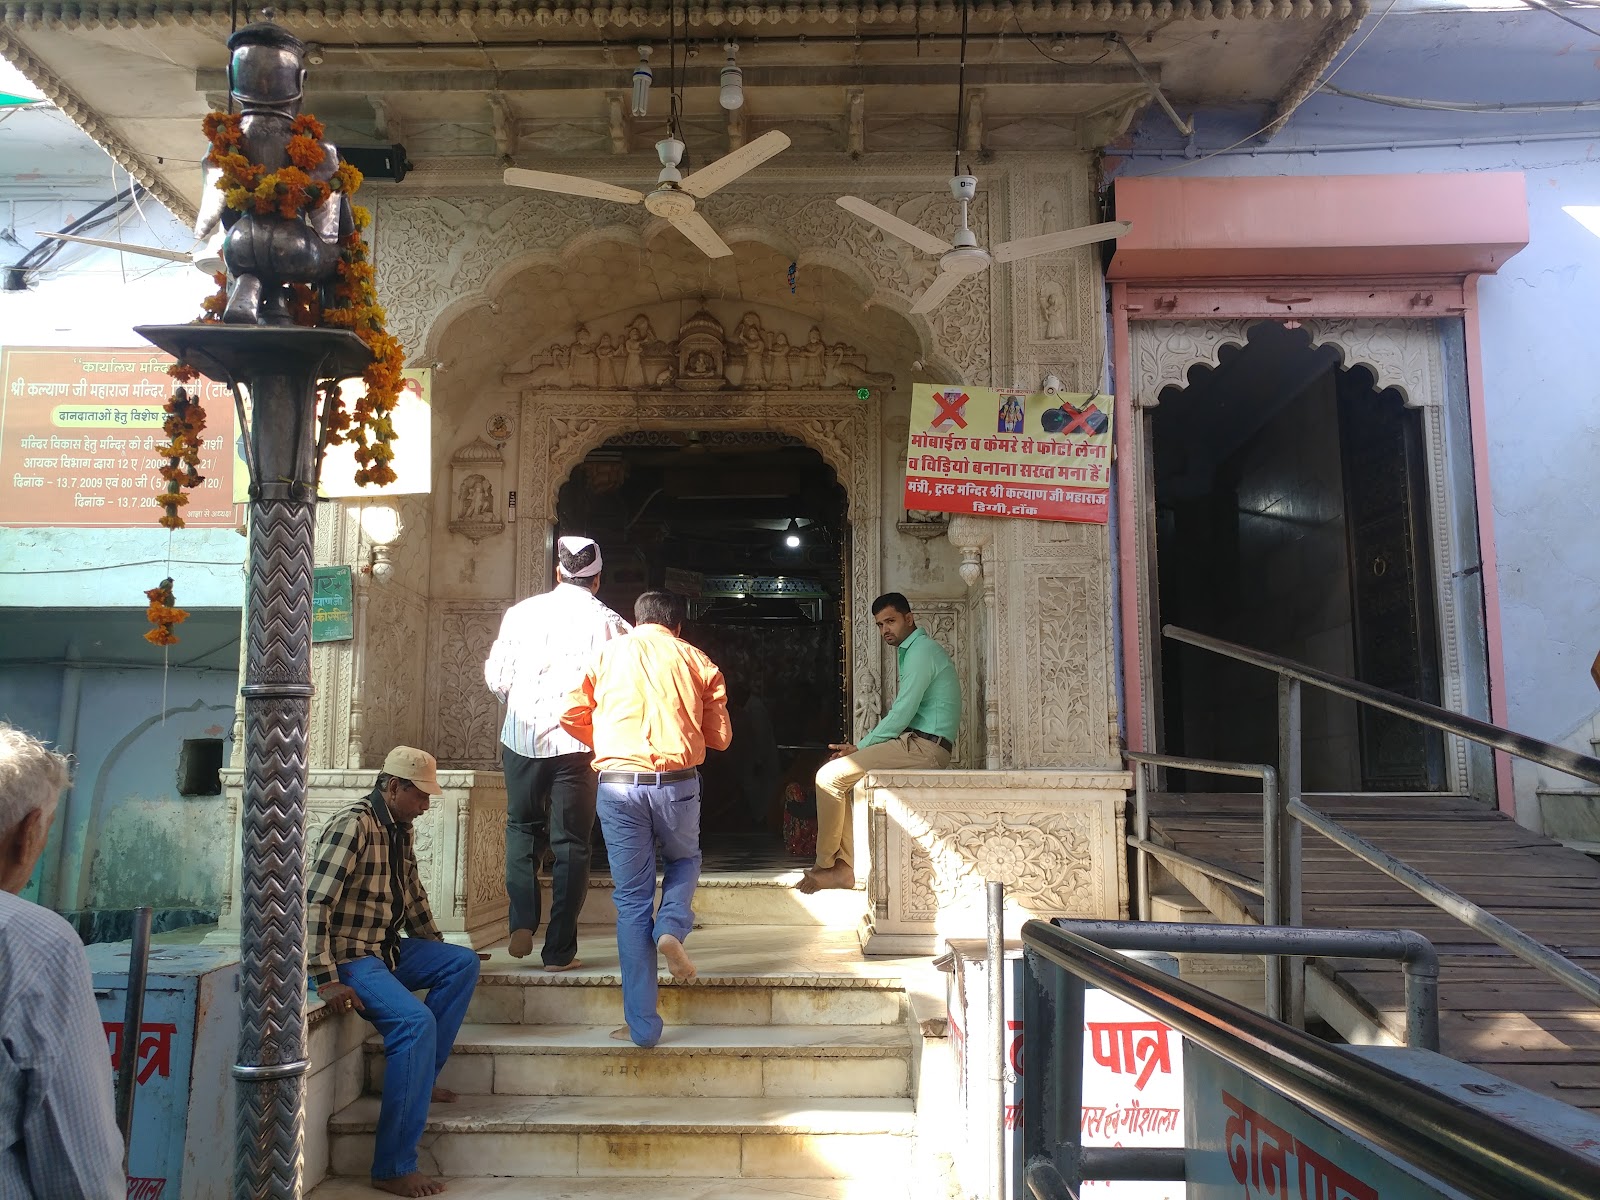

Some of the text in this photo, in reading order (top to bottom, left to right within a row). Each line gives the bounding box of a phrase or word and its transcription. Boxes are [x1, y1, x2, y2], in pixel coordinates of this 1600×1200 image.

[139, 358, 178, 374] मन्दि
[10, 377, 25, 396] श्री
[27, 382, 70, 396] कल्याण
[72, 377, 88, 397] जी
[90, 383, 130, 399] महाराज
[59, 408, 111, 421] दानदाताओं
[114, 408, 128, 425] हेतु
[131, 408, 159, 422] विशेष
[21, 434, 48, 449] मन्दिर
[50, 434, 82, 450] विकास
[84, 435, 97, 454] हेतु
[129, 435, 142, 450] को
[143, 435, 154, 450] दी
[911, 431, 968, 452] मोबाईल
[970, 438, 982, 451] व
[1021, 437, 1035, 454] से
[1037, 438, 1073, 456] फोटो
[1075, 440, 1107, 458] लेना
[24, 457, 58, 469] आयकर
[60, 454, 91, 469] विभाग
[93, 458, 115, 470] द्वारा
[118, 458, 128, 469] 12
[131, 458, 138, 471] ए
[908, 457, 919, 470] व
[972, 461, 1018, 477] बनाना
[1020, 463, 1055, 479] सख्त
[1057, 466, 1087, 481] मना
[13, 473, 44, 487] दिनांक
[56, 477, 102, 489] 13.7.2009
[105, 473, 119, 489] एवं
[121, 478, 132, 488] 80
[135, 473, 148, 488] जी
[74, 492, 105, 507] दिनांक
[957, 482, 988, 497] मन्दिर
[989, 484, 1005, 498] श्री
[1005, 488, 1047, 501] कल्याण
[1049, 488, 1065, 502] जी
[1066, 491, 1108, 504] महाराज
[1086, 1020, 1174, 1092] पात्र
